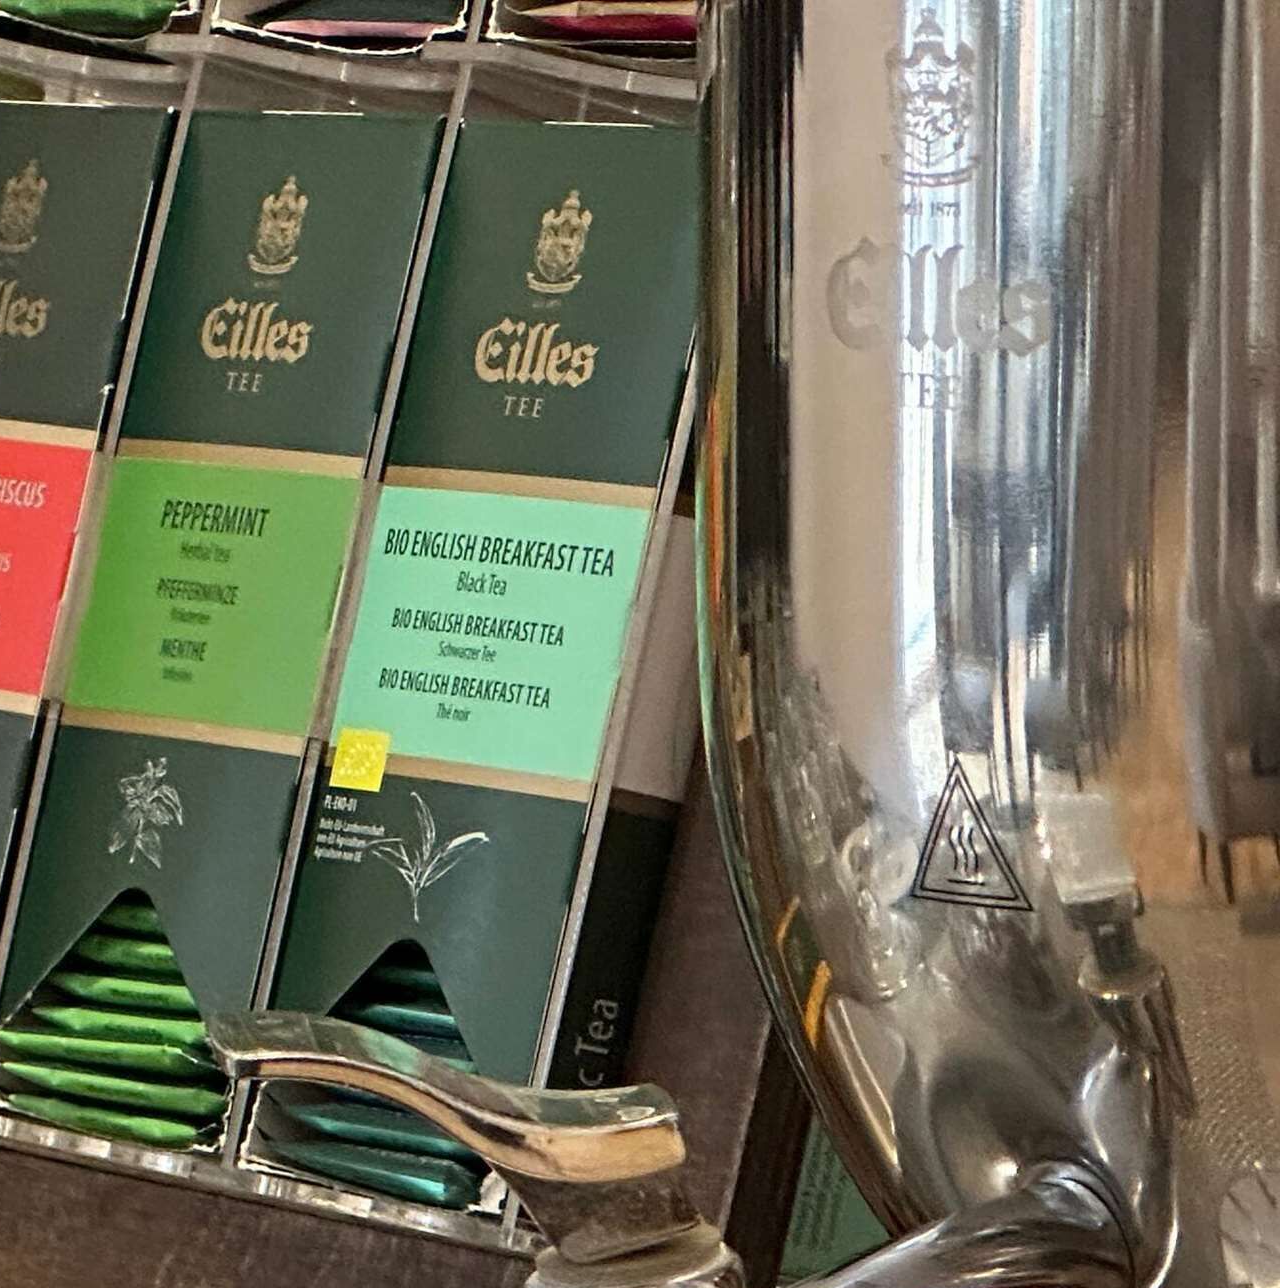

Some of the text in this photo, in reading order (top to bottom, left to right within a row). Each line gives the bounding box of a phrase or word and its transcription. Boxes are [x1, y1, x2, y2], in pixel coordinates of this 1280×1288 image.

[202, 296, 314, 364] Eilles
[475, 317, 600, 388] Eilles
[226, 371, 263, 393] TEE
[504, 395, 544, 418] TEE
[160, 499, 270, 537] PEPPERMINT
[384, 528, 615, 577] BIO ENGLISH BREAKFAST TEA
[456, 571, 507, 596] Black Tea
[392, 607, 564, 647] BIO ENGLISH BREAKFAST TEA
[160, 638, 207, 662] MENTHE
[379, 667, 551, 709] BIO ENGLISH BREAKFAST TEA
[575, 998, 619, 1057] Tea
